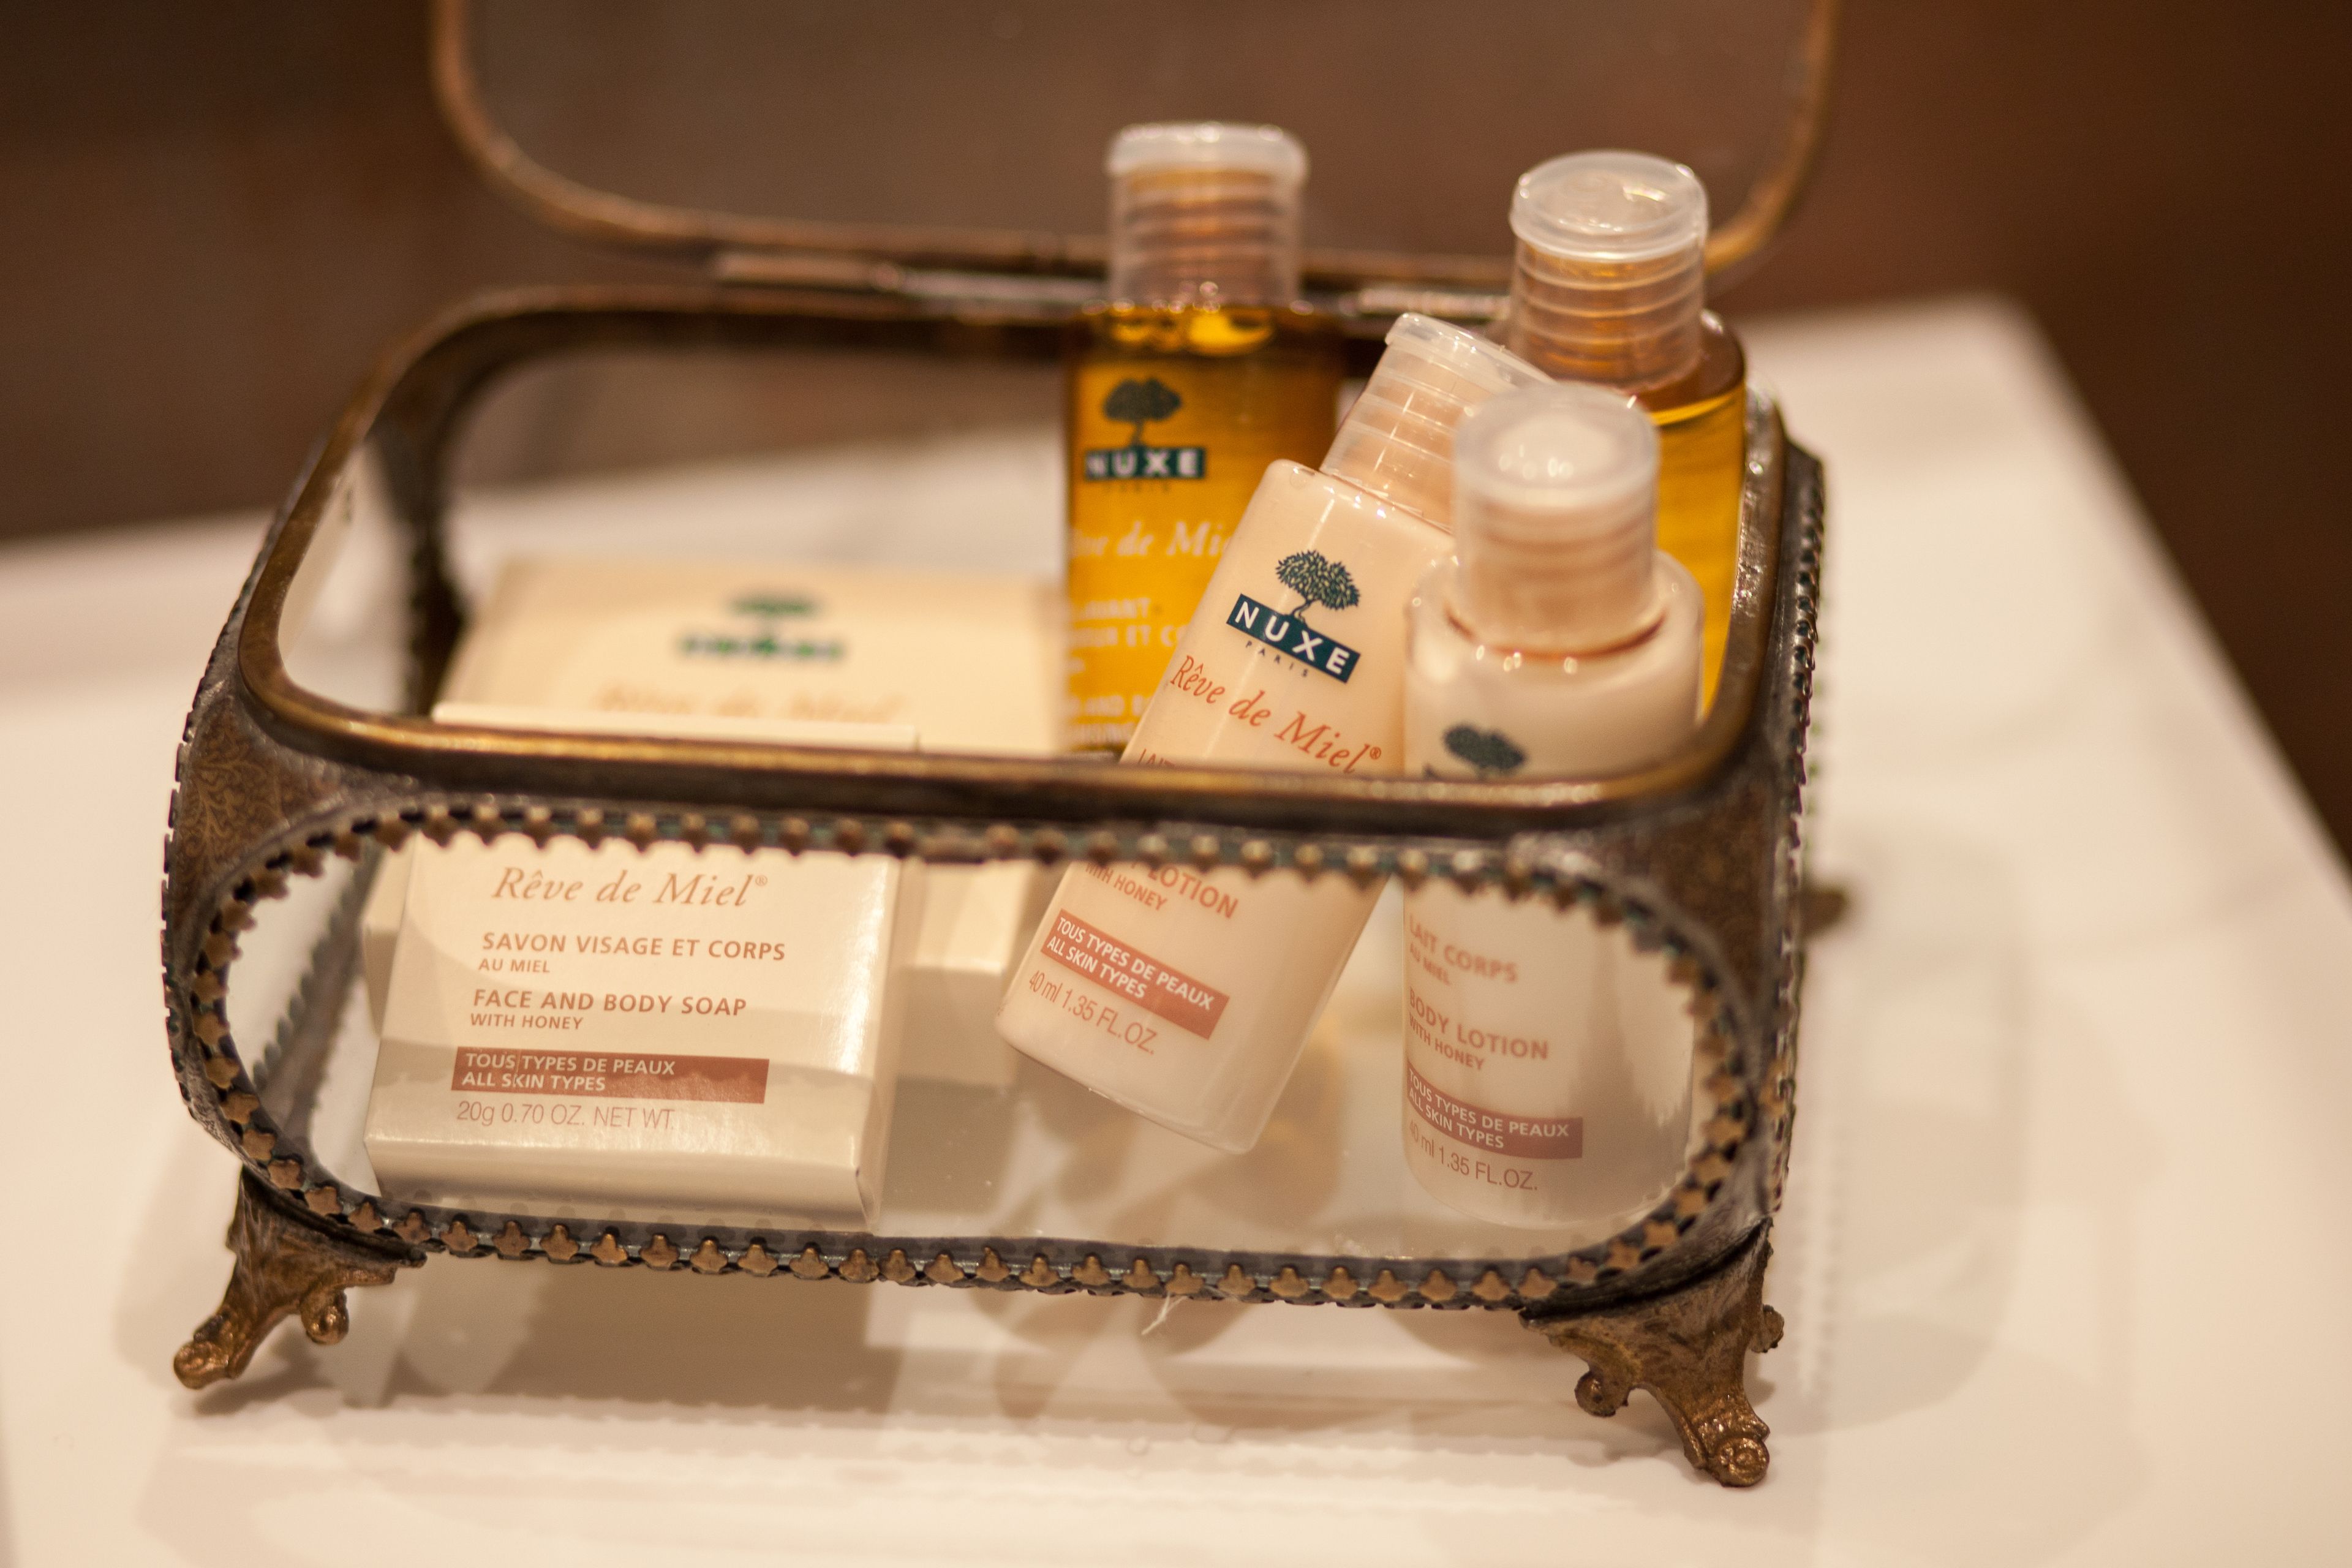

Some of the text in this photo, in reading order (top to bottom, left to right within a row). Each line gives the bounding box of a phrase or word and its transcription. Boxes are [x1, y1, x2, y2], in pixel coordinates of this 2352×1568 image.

[1166, 520, 1231, 557] Mi
[1234, 600, 1351, 675] NUXE
[1245, 639, 1309, 678] PARIS
[1169, 654, 1226, 705] Rêve
[1228, 689, 1272, 727] de
[492, 866, 584, 902] Rêve
[596, 870, 642, 903] de
[1084, 862, 1168, 912] WITH HONEY
[478, 959, 551, 974] AU MIEL
[483, 932, 786, 962] SAVON VISAGE ET CORPS
[1046, 935, 1148, 999] ALL SKIN TYPES
[1056, 917, 1215, 1011] TOUS TYPES DE PEAUX
[1409, 913, 1519, 984] LAIT CORPS
[470, 1012, 584, 1030] WITH HONEY
[473, 989, 747, 1016] FACE AND BODY SOAP
[1029, 969, 1045, 993] 40
[1041, 982, 1064, 1004] ml
[1061, 988, 1098, 1022] 1.35
[1409, 986, 1549, 1061] BODY LOTION
[1409, 1011, 1485, 1071] WITH HONEY
[461, 1072, 606, 1092] ALL SKIN TYPES
[465, 1052, 676, 1076] TOUS TYPES DE PEAUX
[457, 1101, 676, 1131] 20g 0.70 OZ. NET WT.
[1409, 1068, 1570, 1138] TOUS TYPES DE PEAUX
[1409, 1087, 1504, 1149] ALL SKIN TYPES
[1409, 1119, 1420, 1144] 40
[1421, 1134, 1435, 1159] ml
[1439, 1145, 1471, 1177] 1.35
